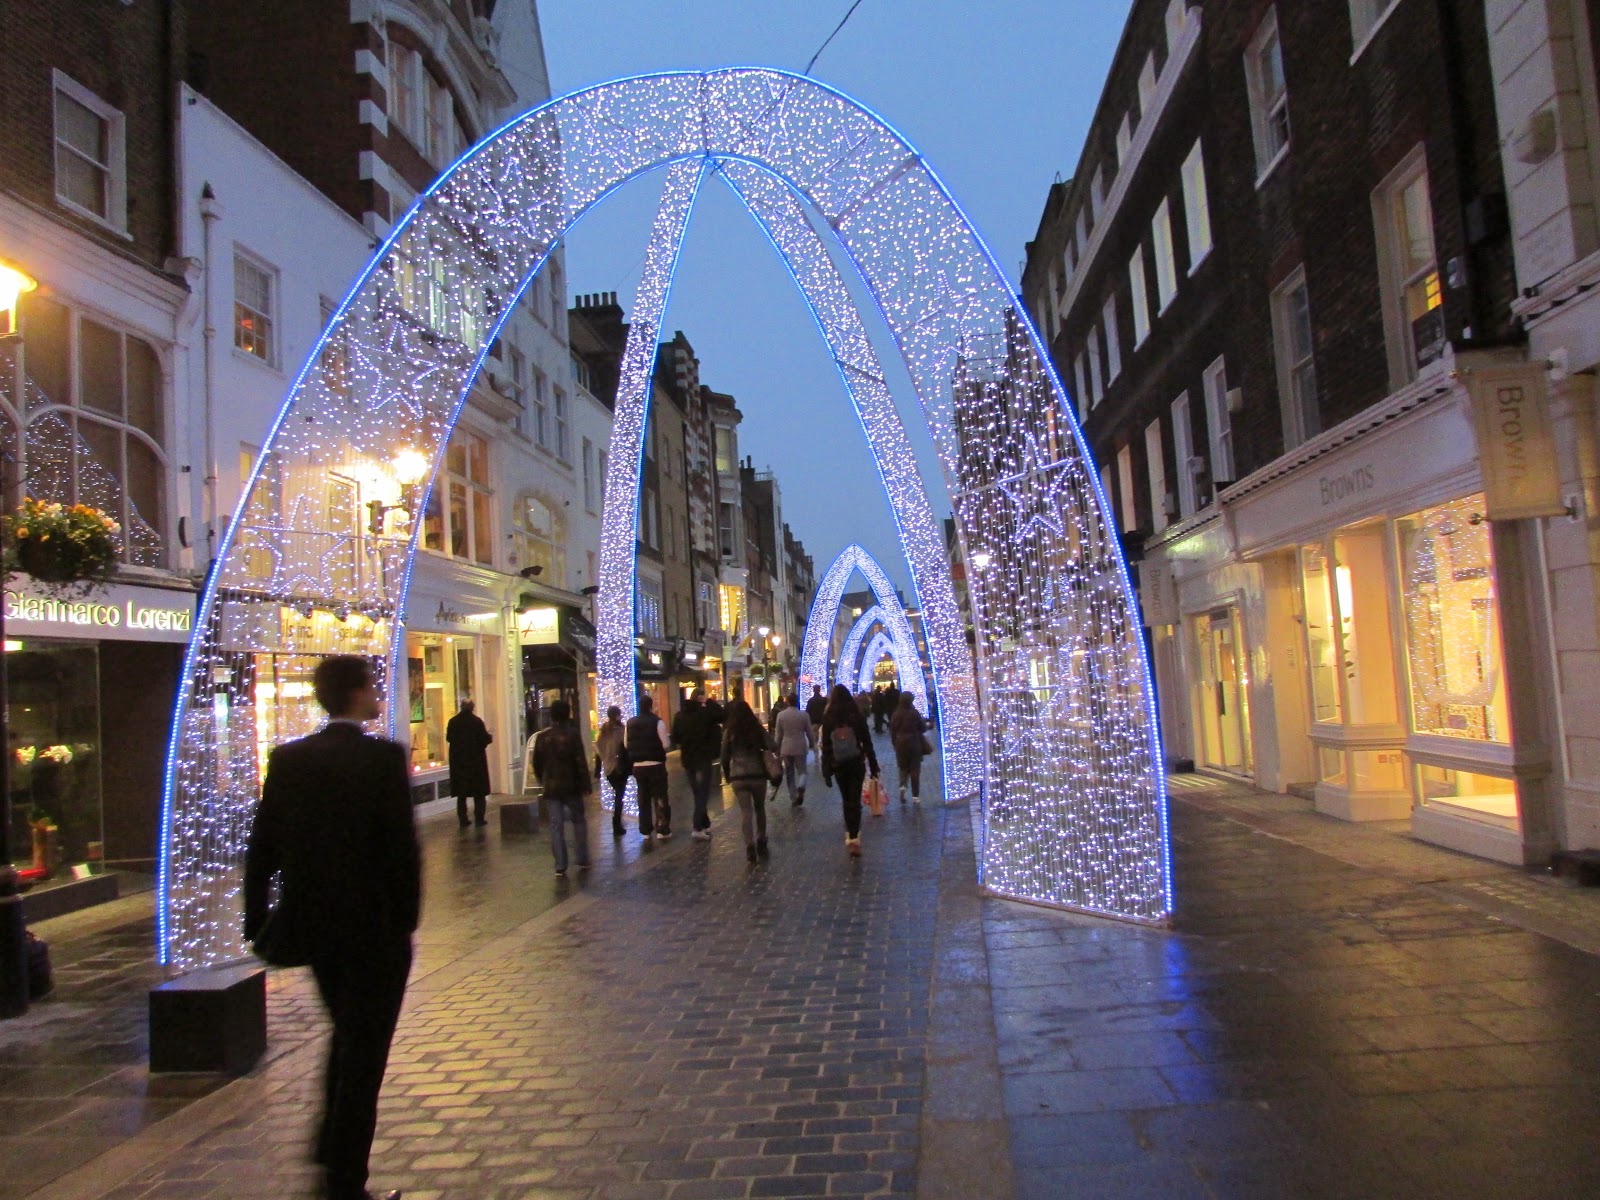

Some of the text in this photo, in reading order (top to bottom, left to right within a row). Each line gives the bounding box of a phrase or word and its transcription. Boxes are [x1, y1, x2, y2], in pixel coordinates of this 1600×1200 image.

[1319, 464, 1375, 505] Browns
[4, 590, 191, 631] Gianmarco Lorenzi
